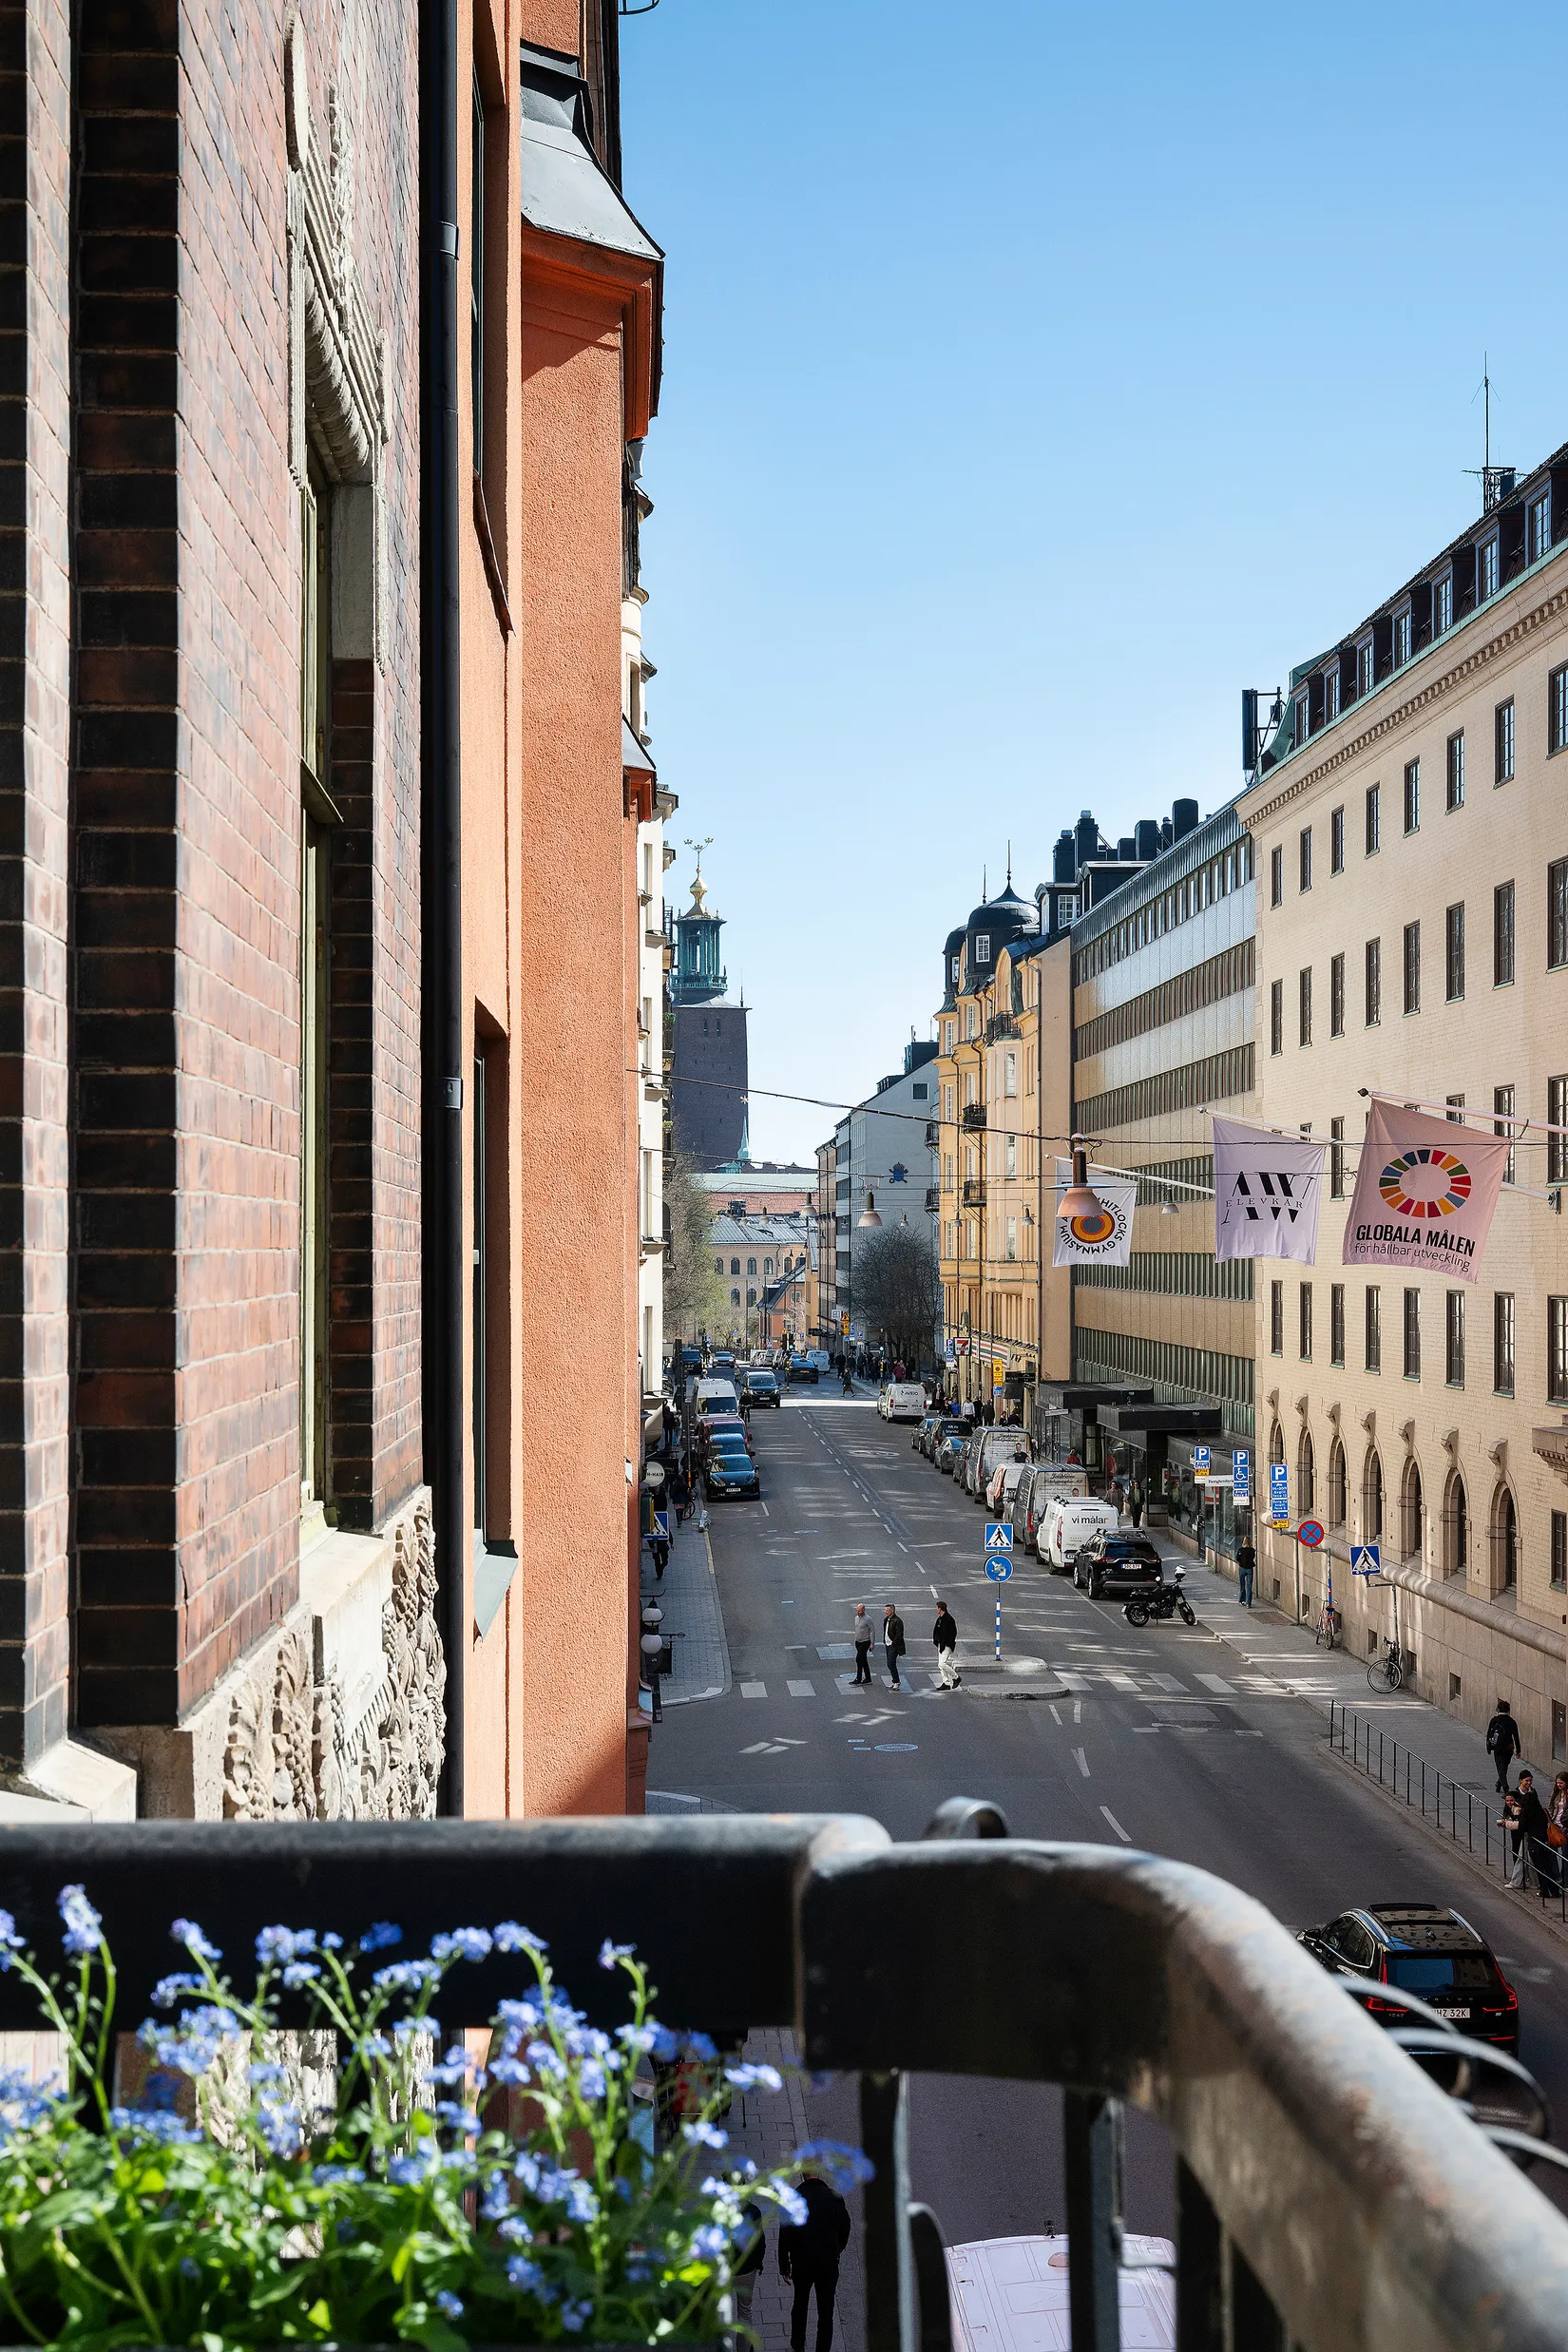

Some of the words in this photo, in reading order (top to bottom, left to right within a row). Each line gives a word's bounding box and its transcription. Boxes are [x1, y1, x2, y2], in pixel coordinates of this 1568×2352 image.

[1098, 1197, 1128, 1241] HITLOCKS
[1060, 1224, 1117, 1254] GYMNASIUM
[1355, 1224, 1422, 1245] GLOBALA
[1425, 1229, 1476, 1257] MÅLEN
[1354, 1243, 1370, 1253] för
[1372, 1243, 1412, 1255] hållbar
[1413, 1248, 1471, 1272] utveckling
[1198, 1447, 1208, 1461] P
[1236, 1451, 1246, 1464] P
[1274, 1466, 1285, 1480] P
[1072, 1516, 1080, 1524] vi
[1081, 1516, 1109, 1524] målar
[1450, 2009, 1466, 2017] 32K
